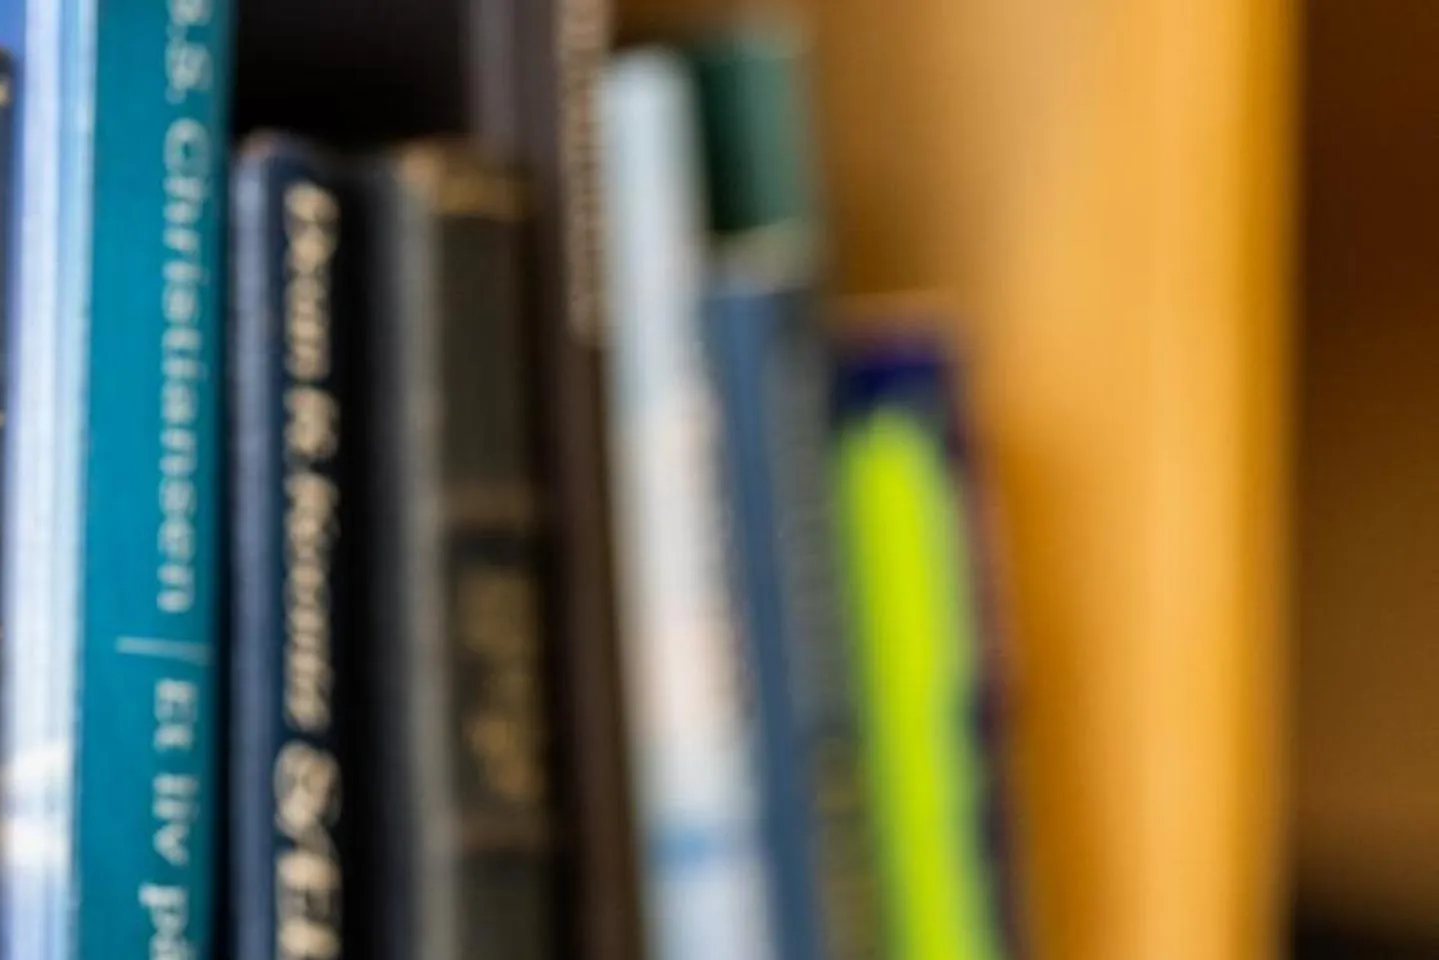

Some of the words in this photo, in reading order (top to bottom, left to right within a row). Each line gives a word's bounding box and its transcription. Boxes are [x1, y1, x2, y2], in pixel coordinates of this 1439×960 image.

[157, 117, 210, 612] Christiansen
[154, 678, 198, 750] Et
[152, 772, 198, 867] liv
